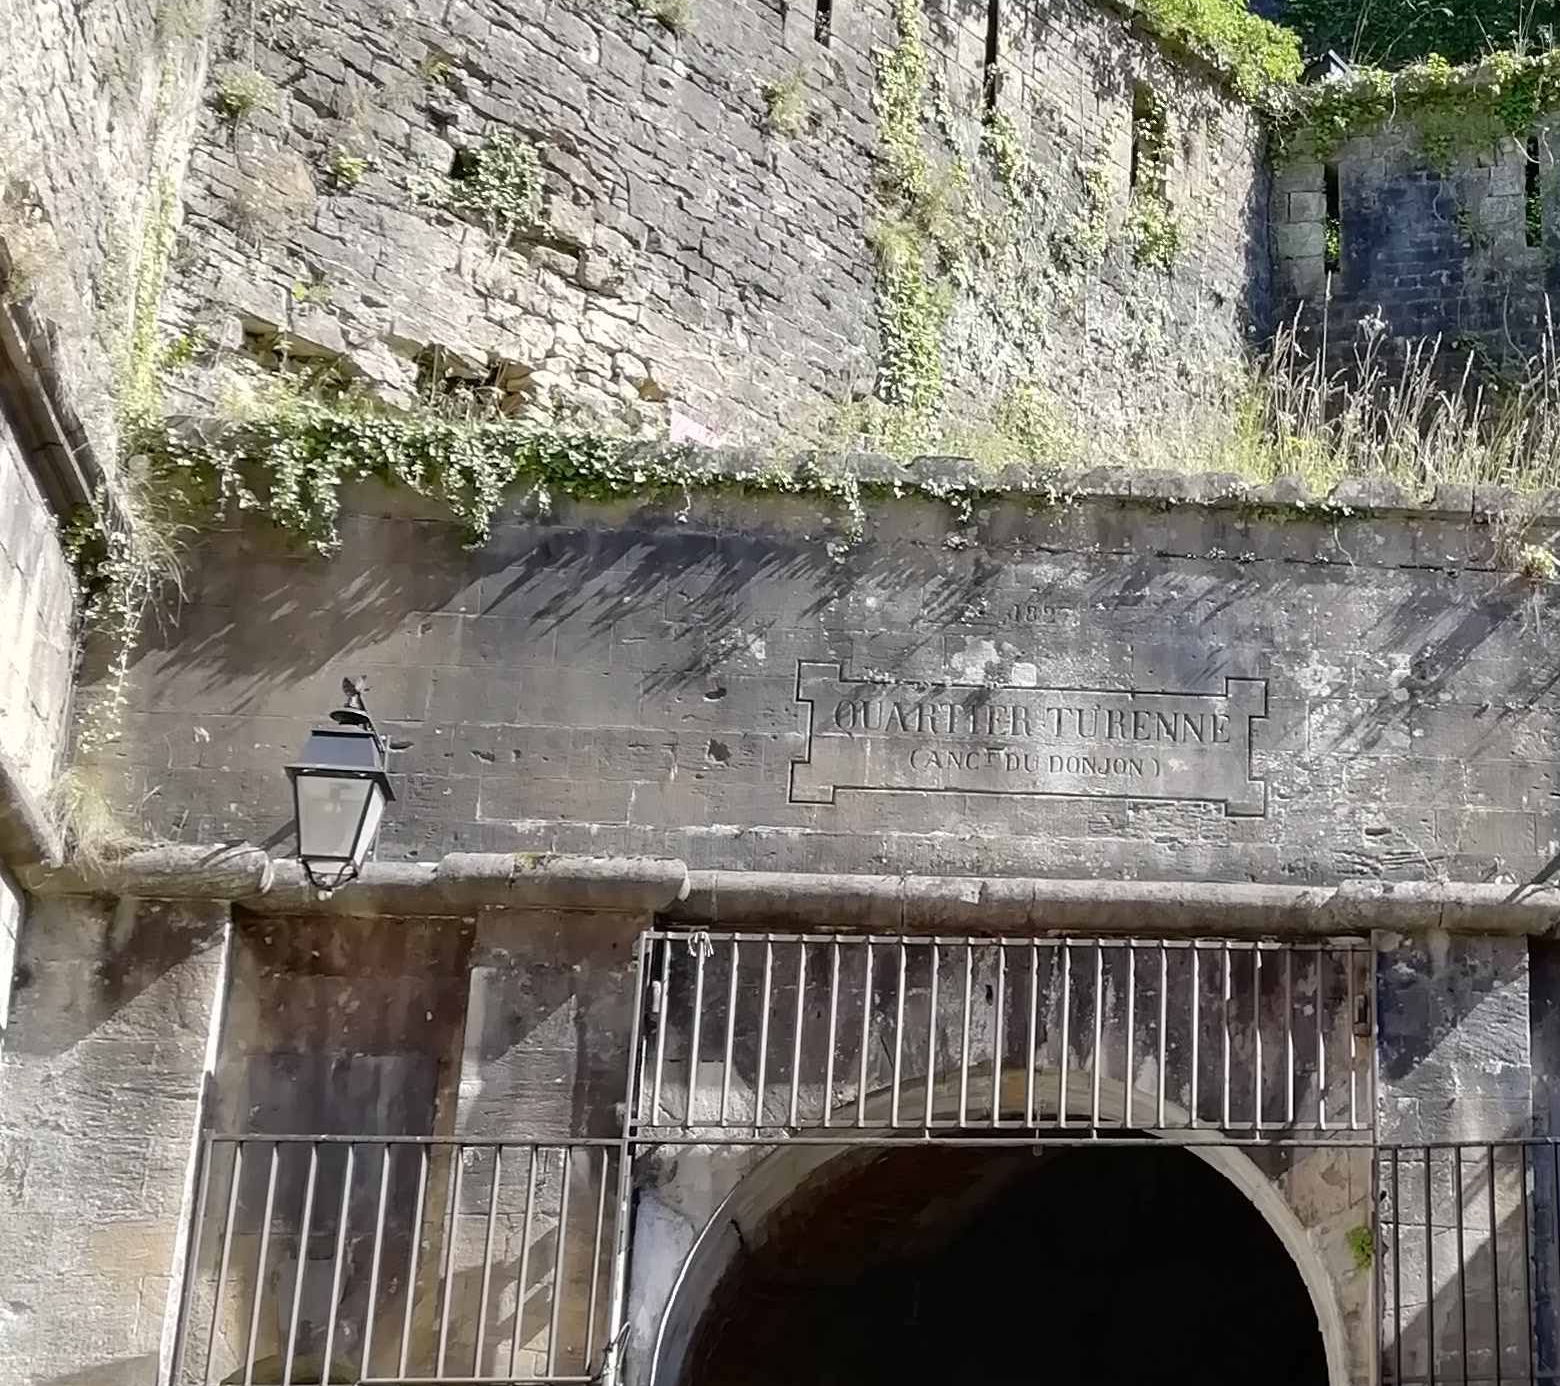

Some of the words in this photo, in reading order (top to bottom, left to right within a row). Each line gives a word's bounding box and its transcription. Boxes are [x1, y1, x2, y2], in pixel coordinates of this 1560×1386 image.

[834, 699, 1033, 737] QUARTIER
[1047, 706, 1231, 744] TURENNE
[1004, 751, 1039, 773] DU
